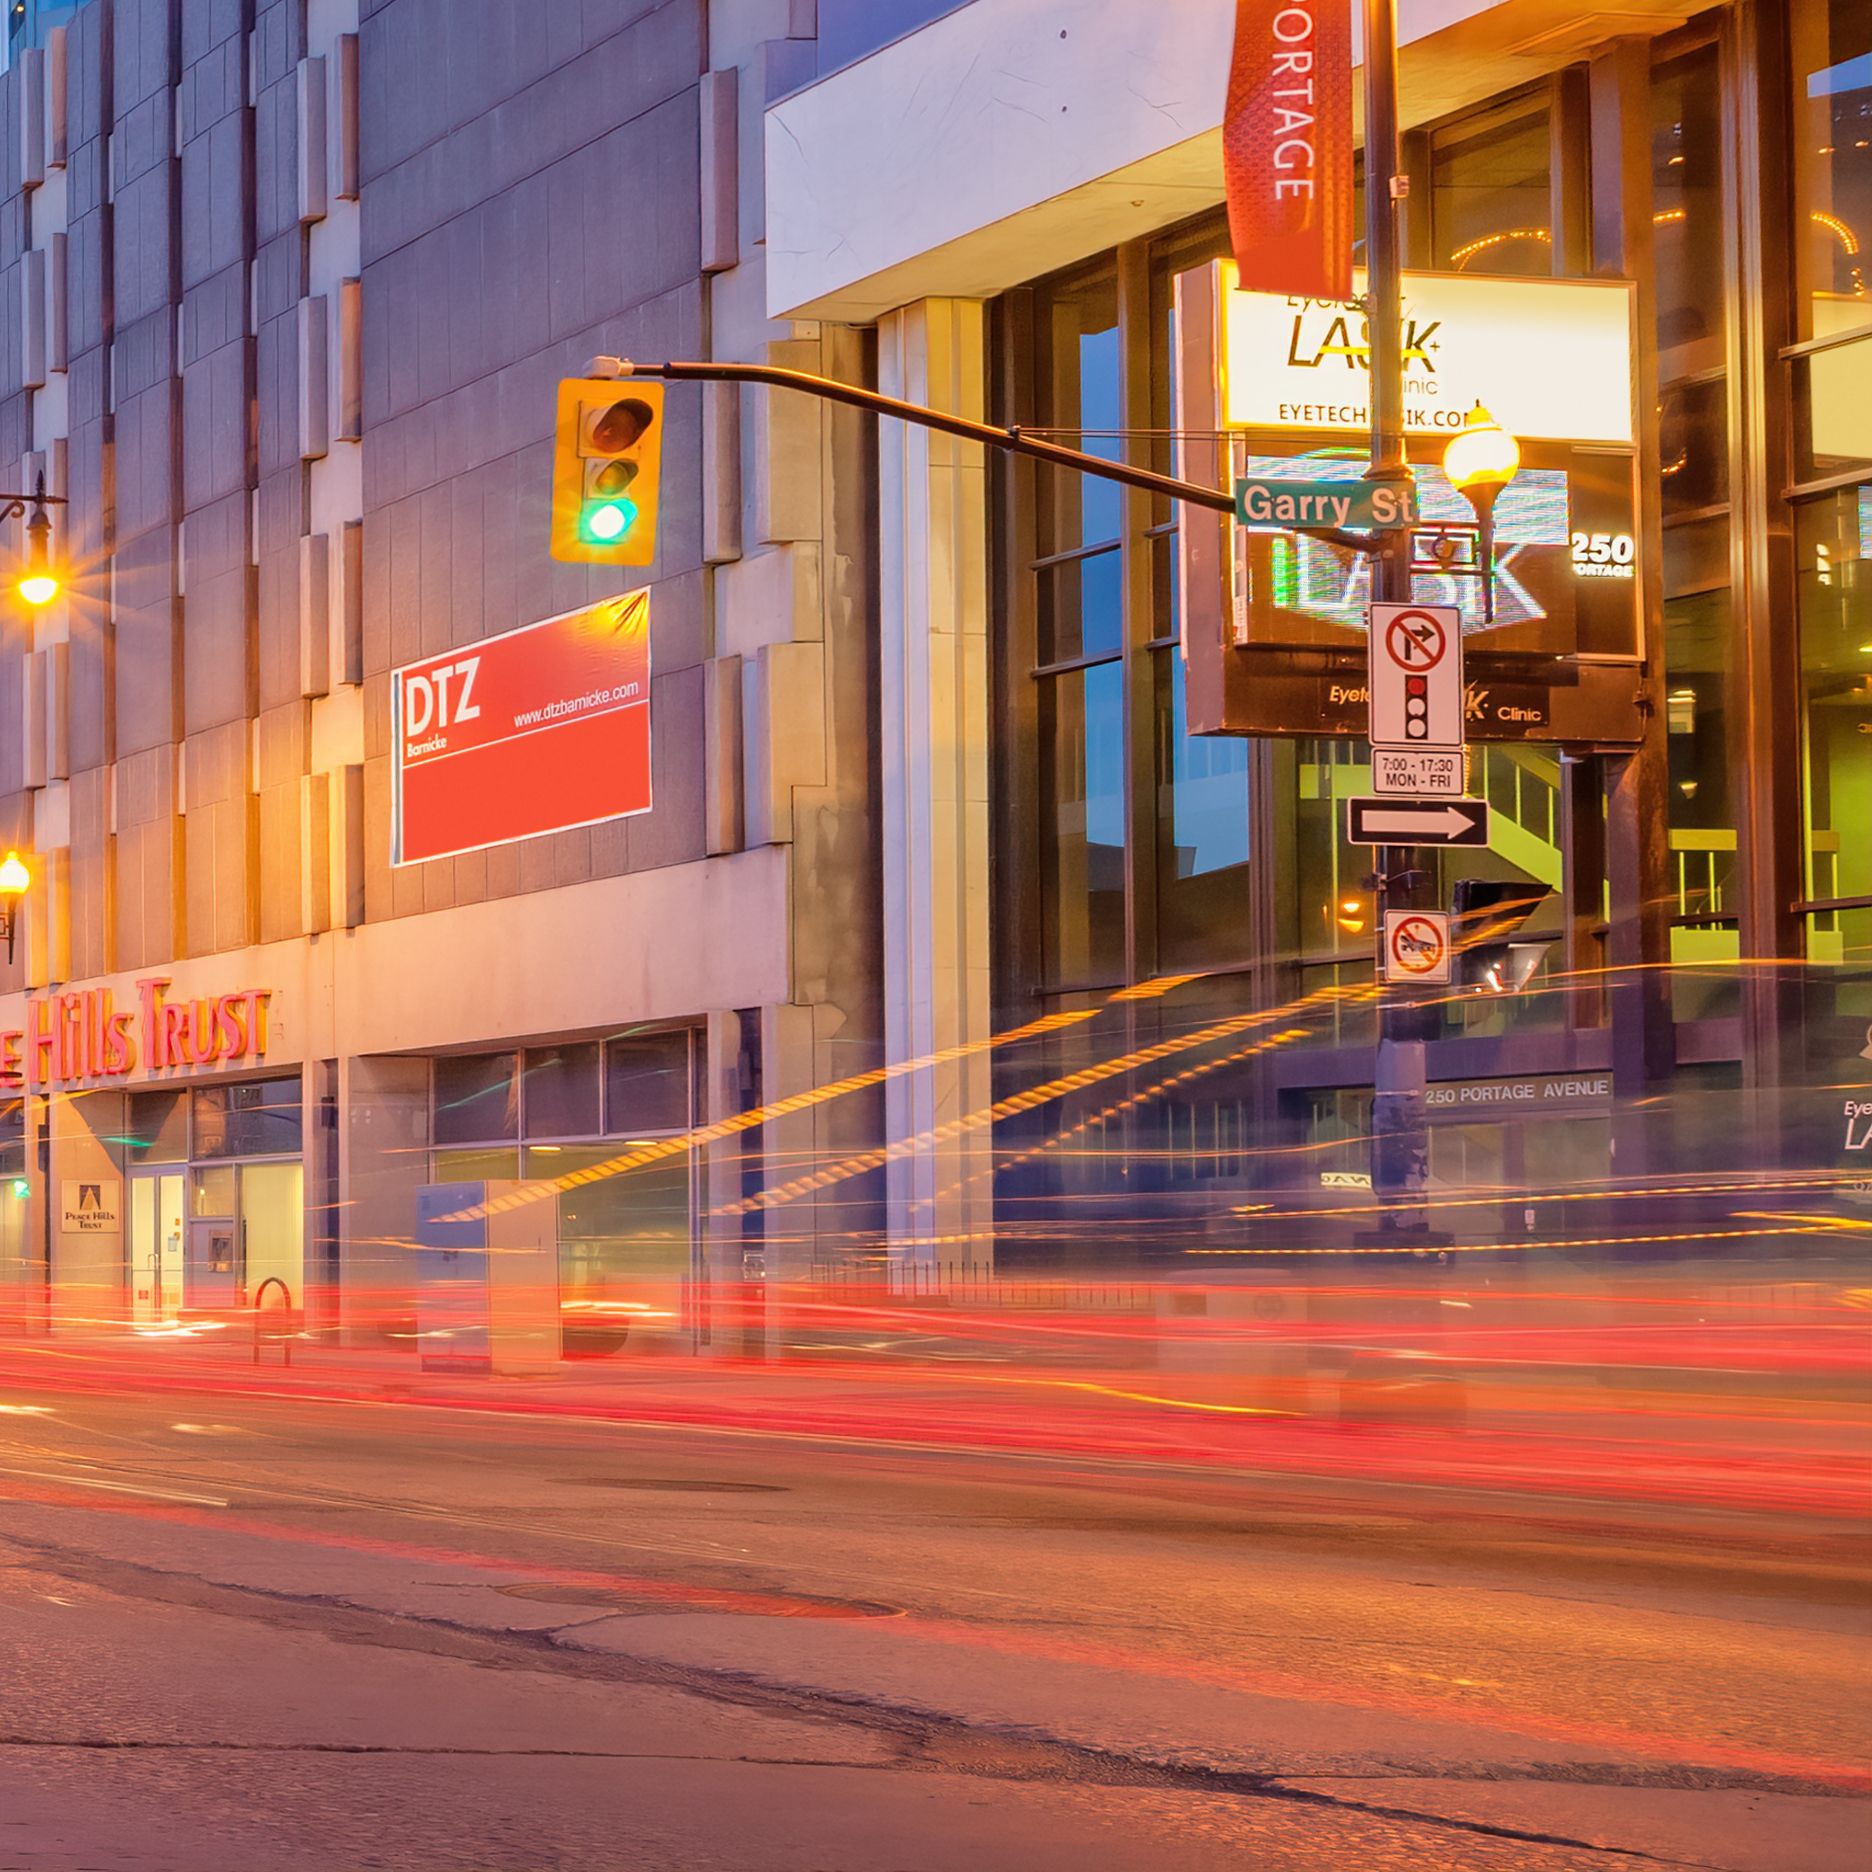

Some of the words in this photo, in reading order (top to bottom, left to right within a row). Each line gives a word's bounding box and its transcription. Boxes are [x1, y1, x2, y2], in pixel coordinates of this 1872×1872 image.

[1243, 483, 1350, 528] Garry
[1371, 488, 1414, 524] St
[1571, 532, 1634, 564] 250
[1572, 562, 1634, 577] ORTAGE
[406, 656, 481, 738] DTZ
[513, 681, 639, 729] www.dtzbarnicke.com
[1497, 706, 1543, 722] Clinic
[406, 733, 448, 759] Barnicke
[1382, 758, 1407, 771] 7:00
[1420, 759, 1454, 773] 17:30
[1386, 773, 1417, 786] MON
[1430, 775, 1451, 788] FRI
[136, 976, 272, 1070] TRUST
[1426, 1091, 1455, 1104] 250
[1459, 1084, 1535, 1101] PORTAGE
[1543, 1080, 1609, 1097] AVENUE
[79, 1220, 102, 1229] TRUST
